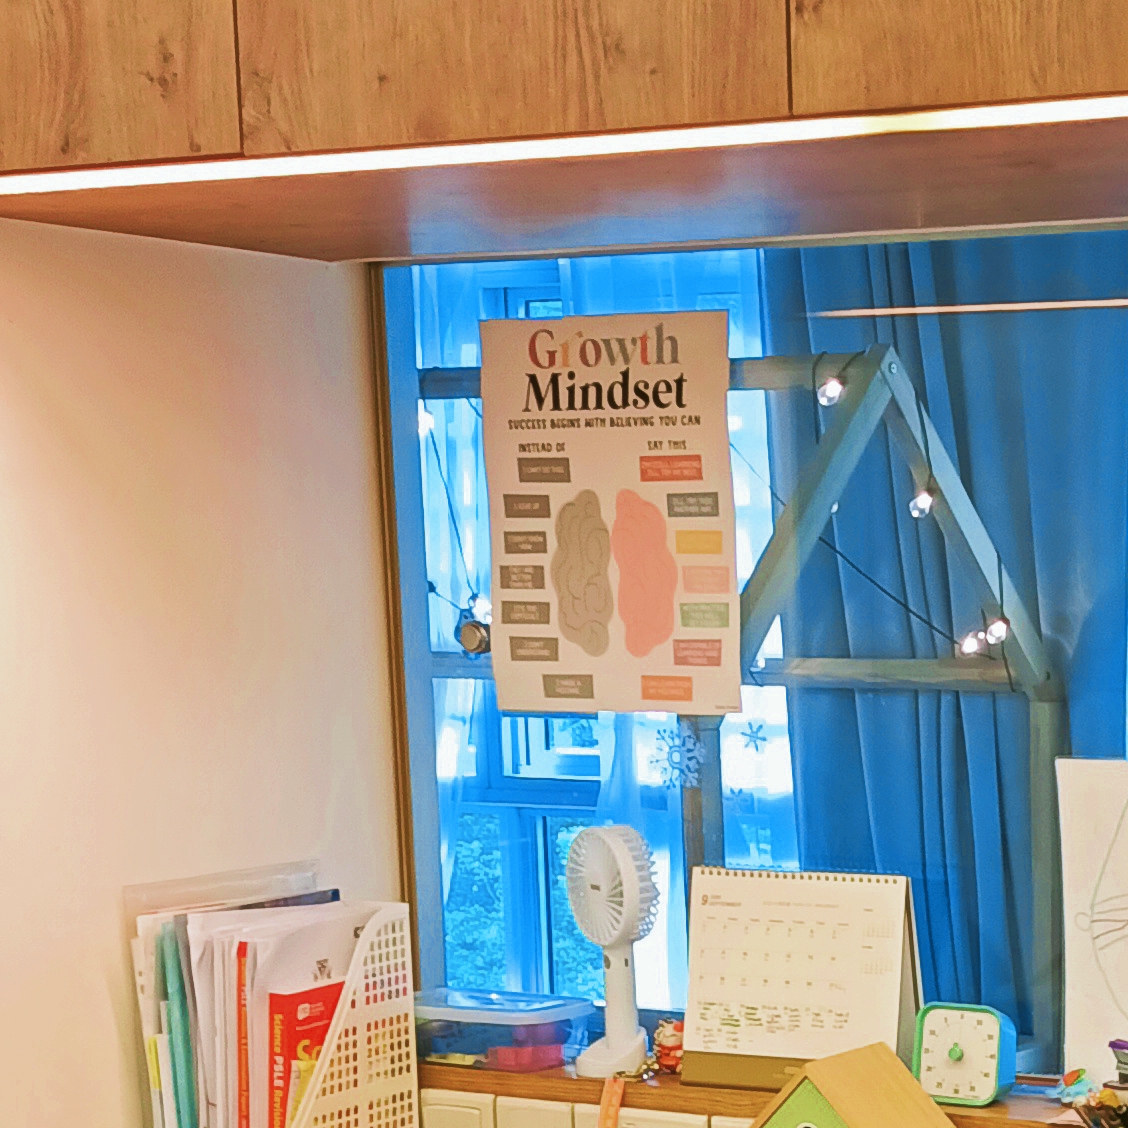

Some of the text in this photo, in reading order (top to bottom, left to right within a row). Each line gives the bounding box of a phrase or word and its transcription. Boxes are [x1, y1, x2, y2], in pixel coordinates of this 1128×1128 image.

[528, 322, 680, 370] Growth
[522, 367, 688, 412] Mindset
[508, 415, 701, 430] SUCCESS BEGINS WITH BELIEVING YOU CAN
[647, 439, 687, 451] SAY THIS
[273, 1014, 283, 1053] Science
[273, 1056, 284, 1087] PSLE
